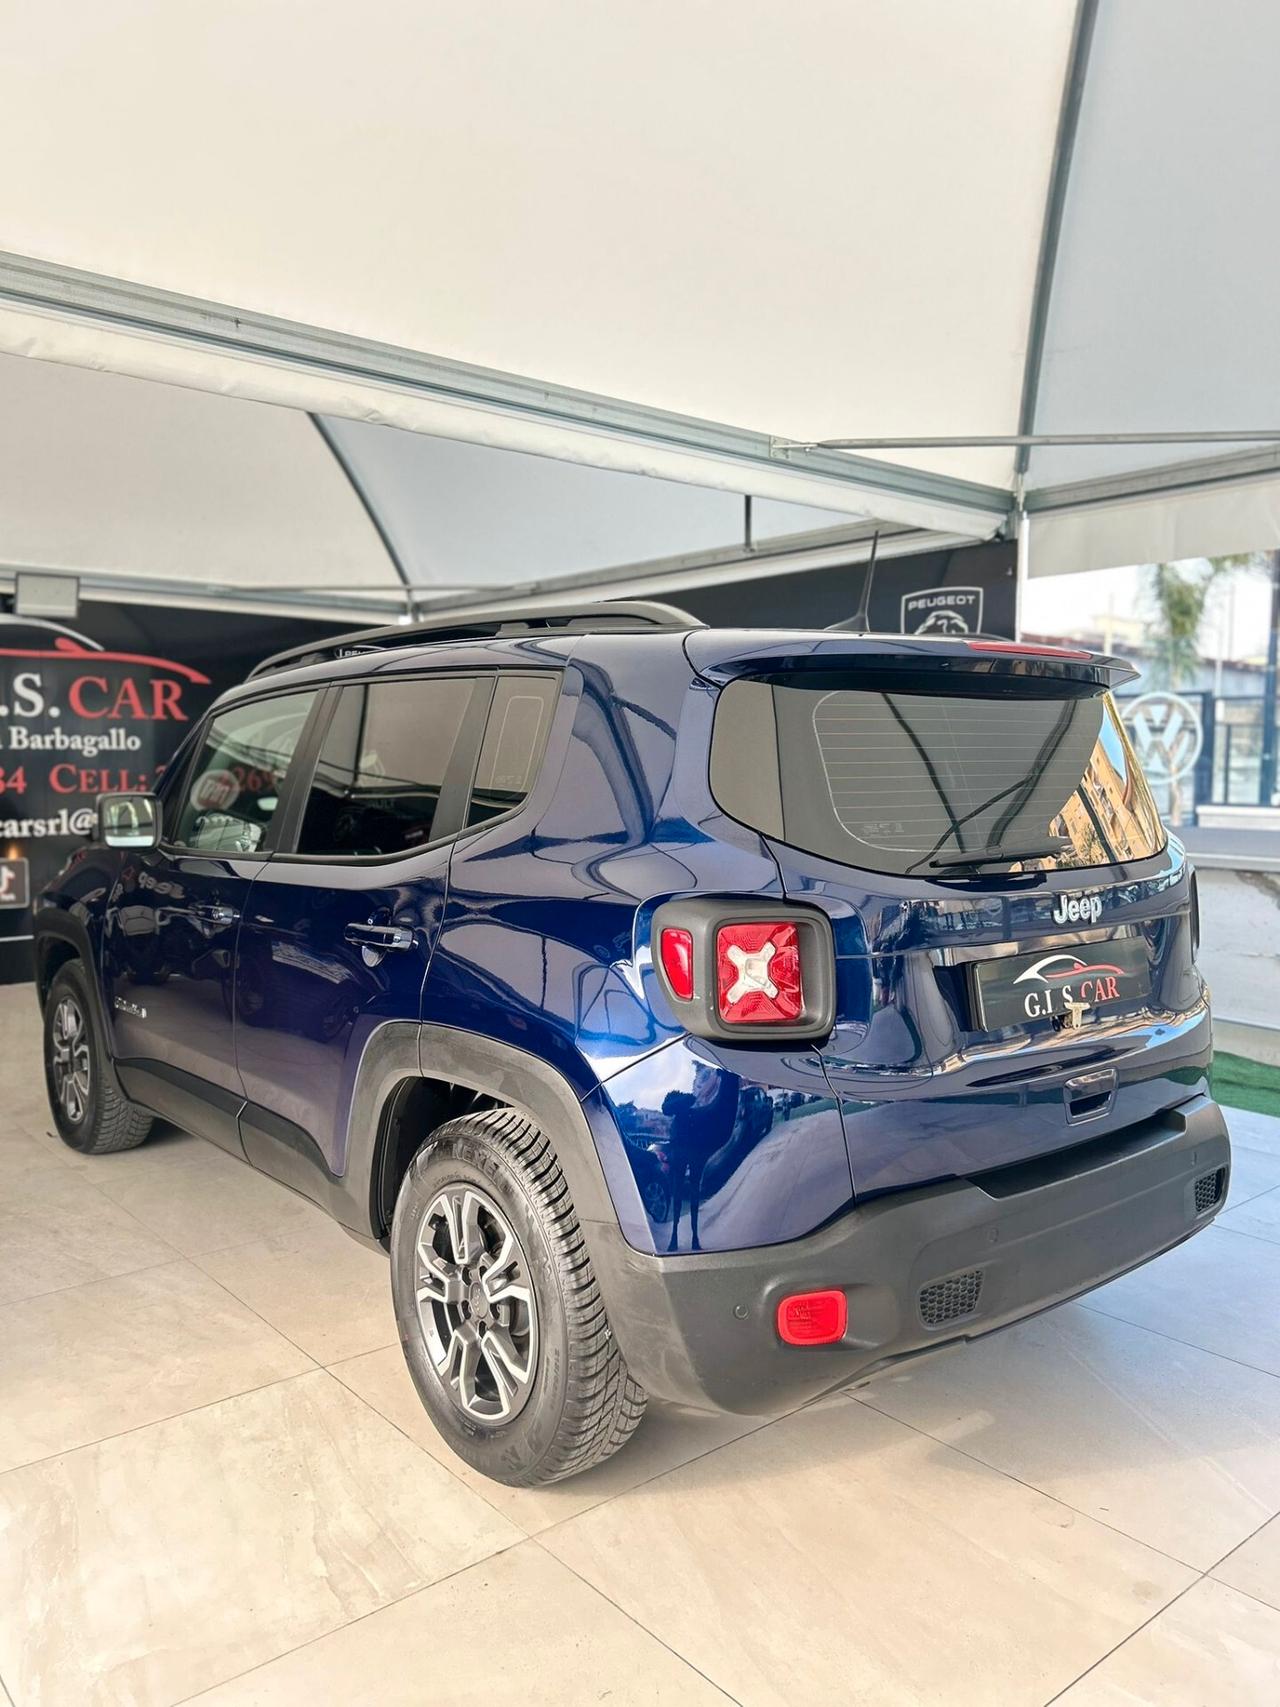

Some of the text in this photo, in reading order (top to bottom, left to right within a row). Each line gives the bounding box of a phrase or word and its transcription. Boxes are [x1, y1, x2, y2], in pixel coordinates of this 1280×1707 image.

[908, 595, 976, 611] PEUGEOT
[69, 675, 189, 721] CAR
[8, 726, 141, 758] Barbagallo
[1053, 894, 1103, 924] Jeep
